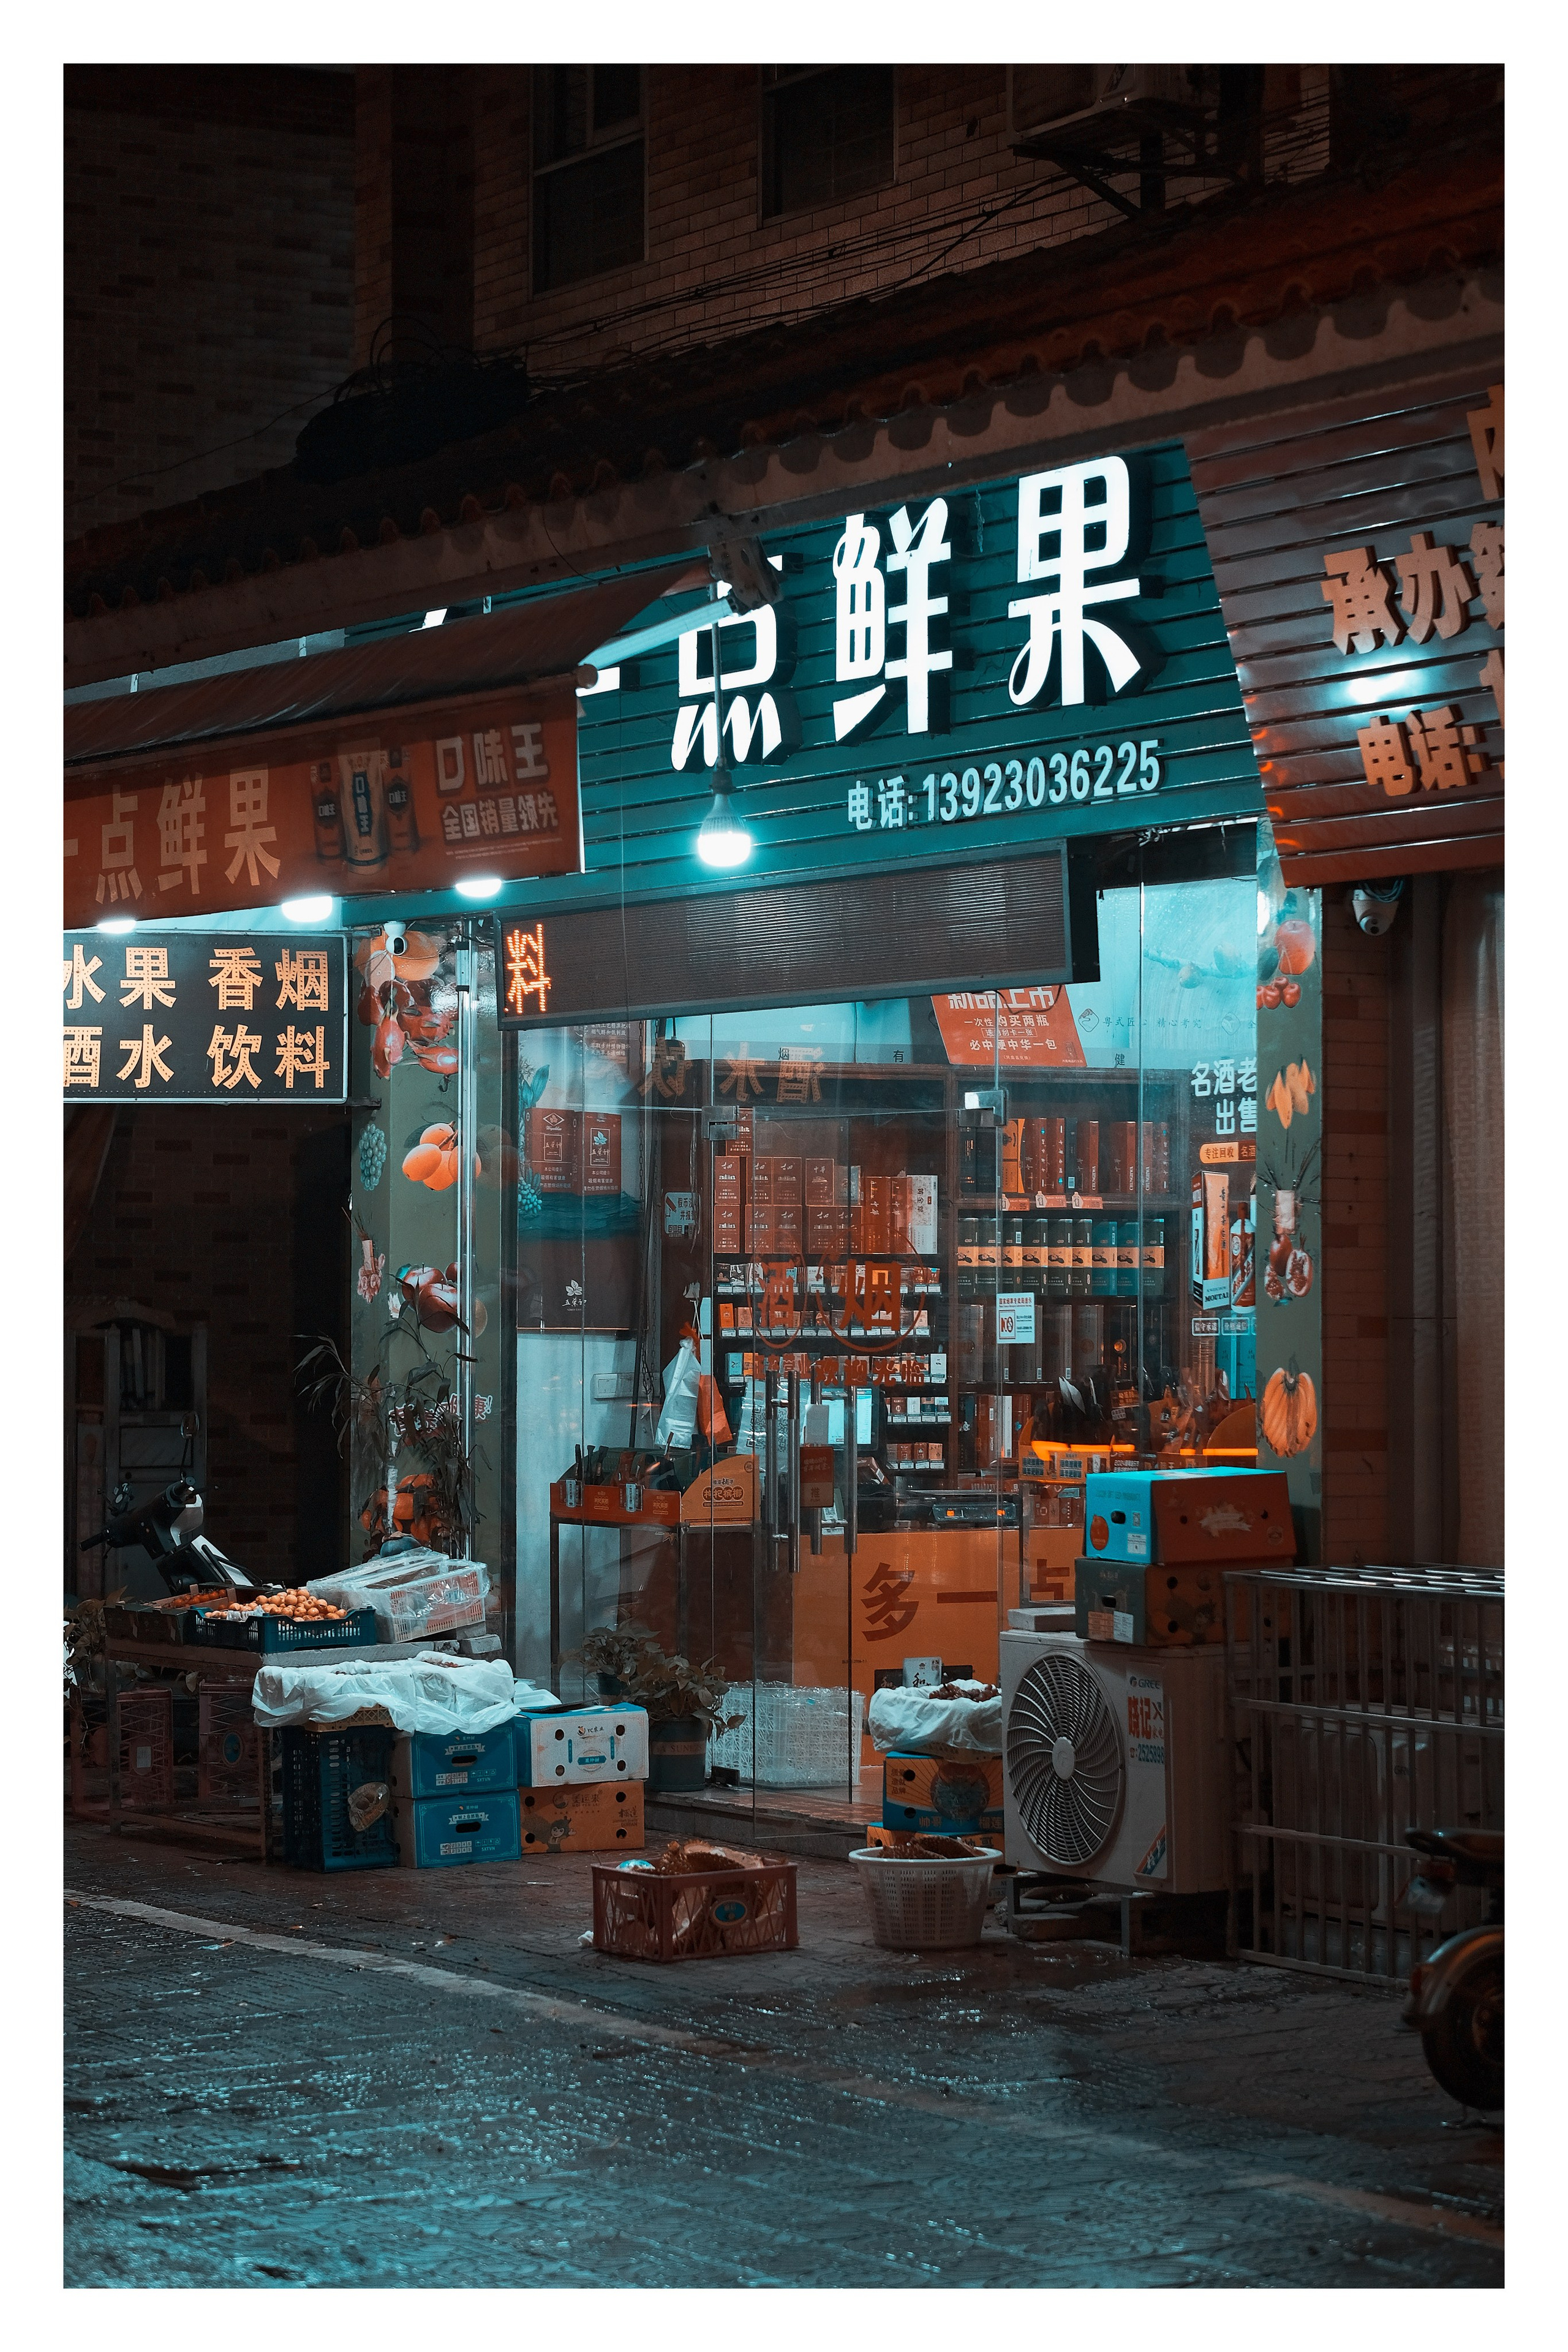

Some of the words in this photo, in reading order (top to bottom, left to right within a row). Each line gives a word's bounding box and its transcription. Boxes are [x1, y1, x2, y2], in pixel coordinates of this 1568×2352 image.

[435, 722, 549, 791] 口味王
[442, 791, 559, 841] 全国销量领先
[63, 944, 177, 1010] 水果
[208, 947, 330, 1012] 香烟
[506, 923, 551, 1014] 料
[63, 1023, 175, 1088] 酒水
[206, 1023, 330, 1090] 饮料
[1191, 1057, 1257, 1097] 名酒老
[1215, 1096, 1257, 1135] 出售
[1204, 1146, 1234, 1159] 专注回收
[837, 1259, 903, 1331] 烟
[815, 1355, 925, 1387] 欢迎光临
[1138, 1678, 1161, 1689] GREE
[919, 1815, 943, 1828] 帅哥
